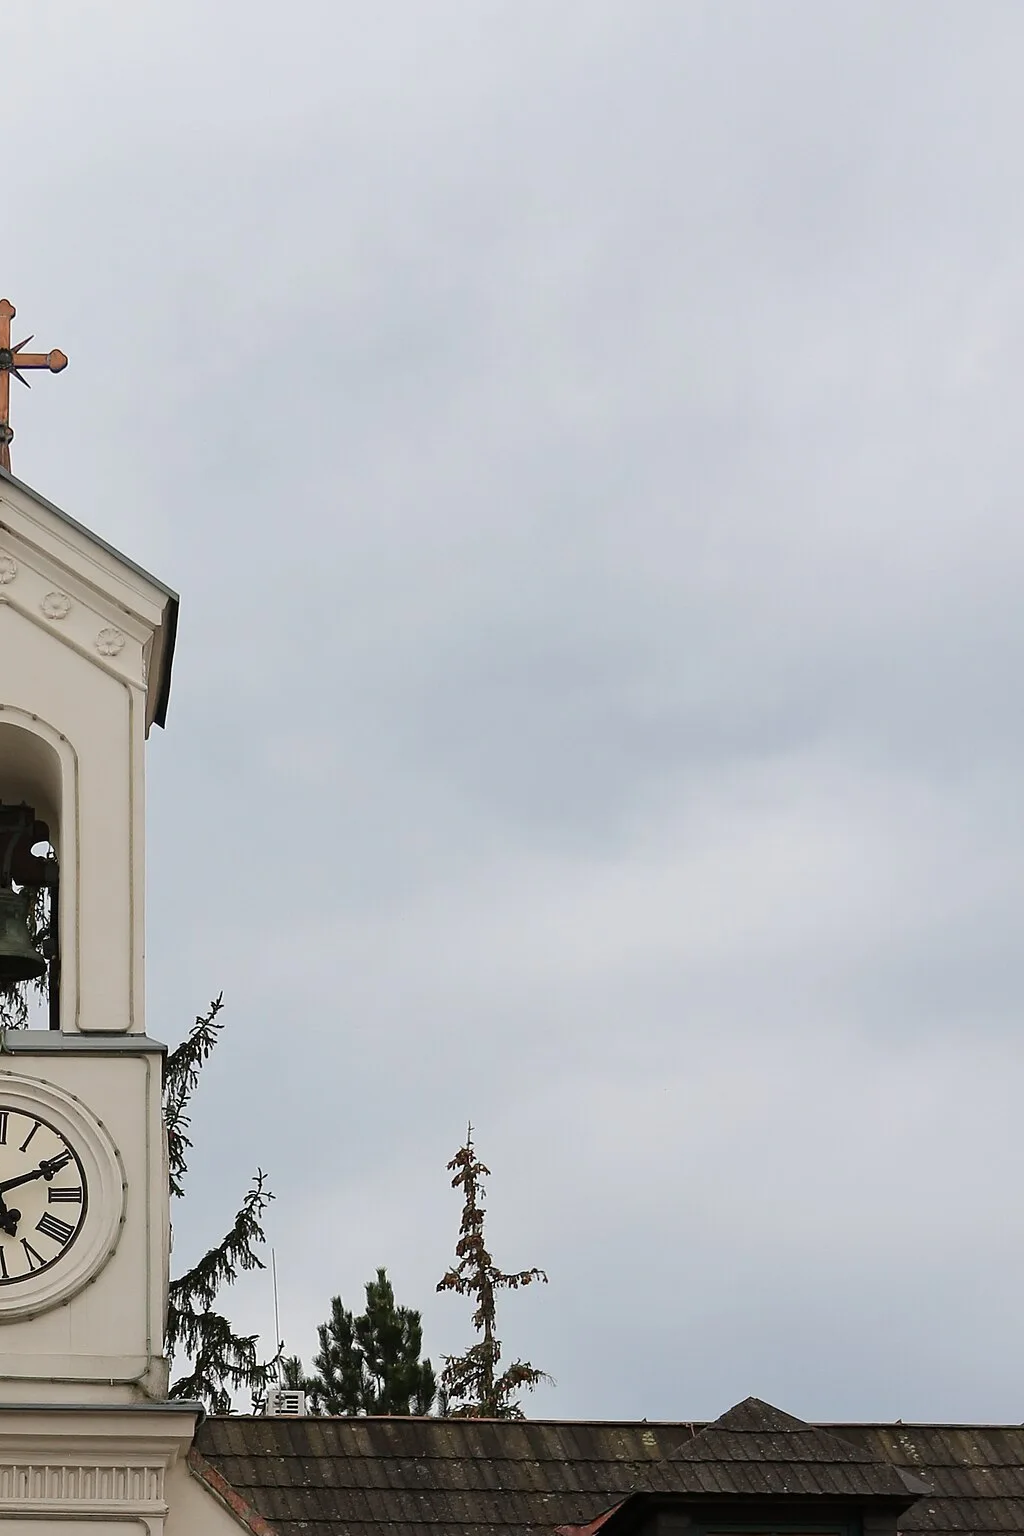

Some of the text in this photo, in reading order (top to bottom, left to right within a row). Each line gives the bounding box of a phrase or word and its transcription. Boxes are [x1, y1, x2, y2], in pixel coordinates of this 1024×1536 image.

[19, 1122, 41, 1152] I
[48, 1186, 82, 1204] III
[35, 1212, 75, 1246] IIII
[20, 1238, 47, 1271] V
